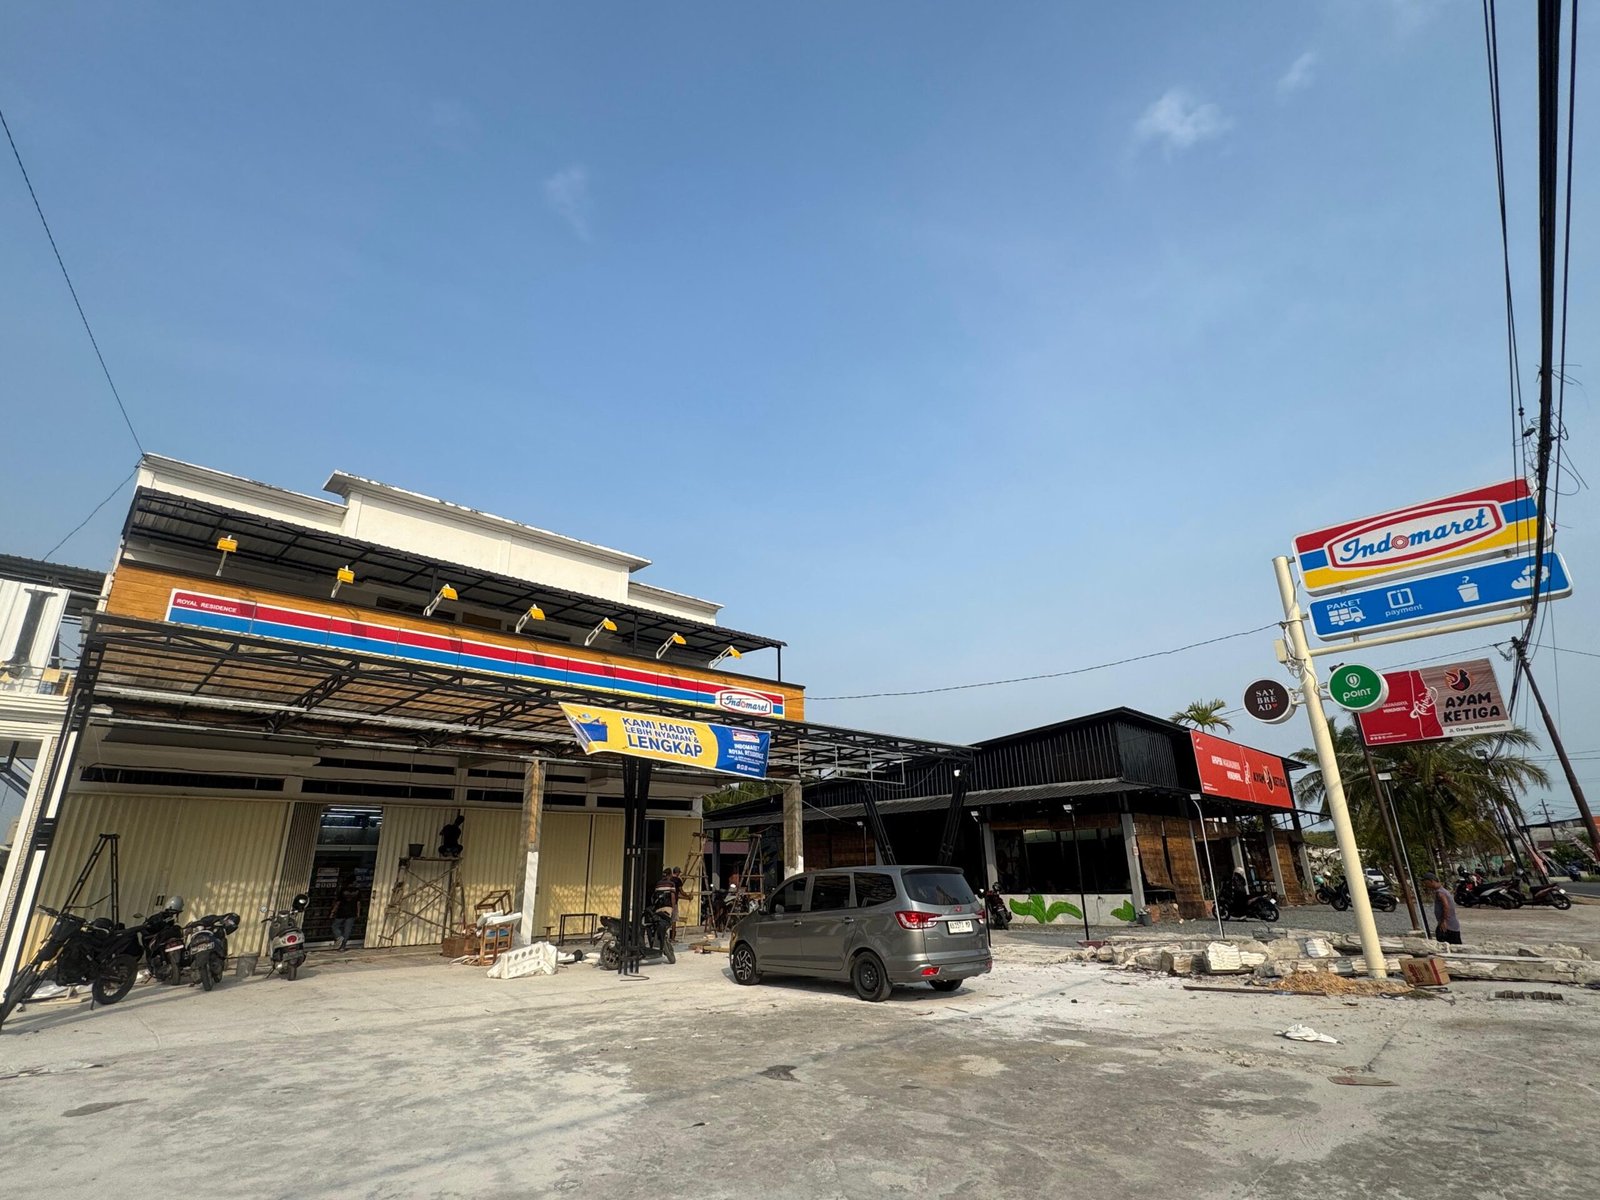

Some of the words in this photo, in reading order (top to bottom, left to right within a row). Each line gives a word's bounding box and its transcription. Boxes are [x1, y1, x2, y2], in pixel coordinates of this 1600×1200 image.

[1340, 508, 1490, 563] Indomaret
[176, 598, 198, 607] ROYAL
[200, 602, 238, 613] RESIDENCE
[1326, 598, 1361, 611] PAKET
[1385, 604, 1424, 618] payment
[1255, 688, 1275, 698] SAY
[1257, 696, 1277, 705] BRE
[1445, 691, 1492, 709] AYAM
[723, 695, 769, 712] Indomaret
[1258, 703, 1272, 712] AD
[1443, 705, 1500, 723] KETIGA
[622, 717, 656, 730] KAMI
[658, 722, 697, 736] HADIR
[625, 726, 653, 736] LEBIH
[654, 730, 692, 743] NYAMAN
[627, 734, 703, 757] LENGKAP
